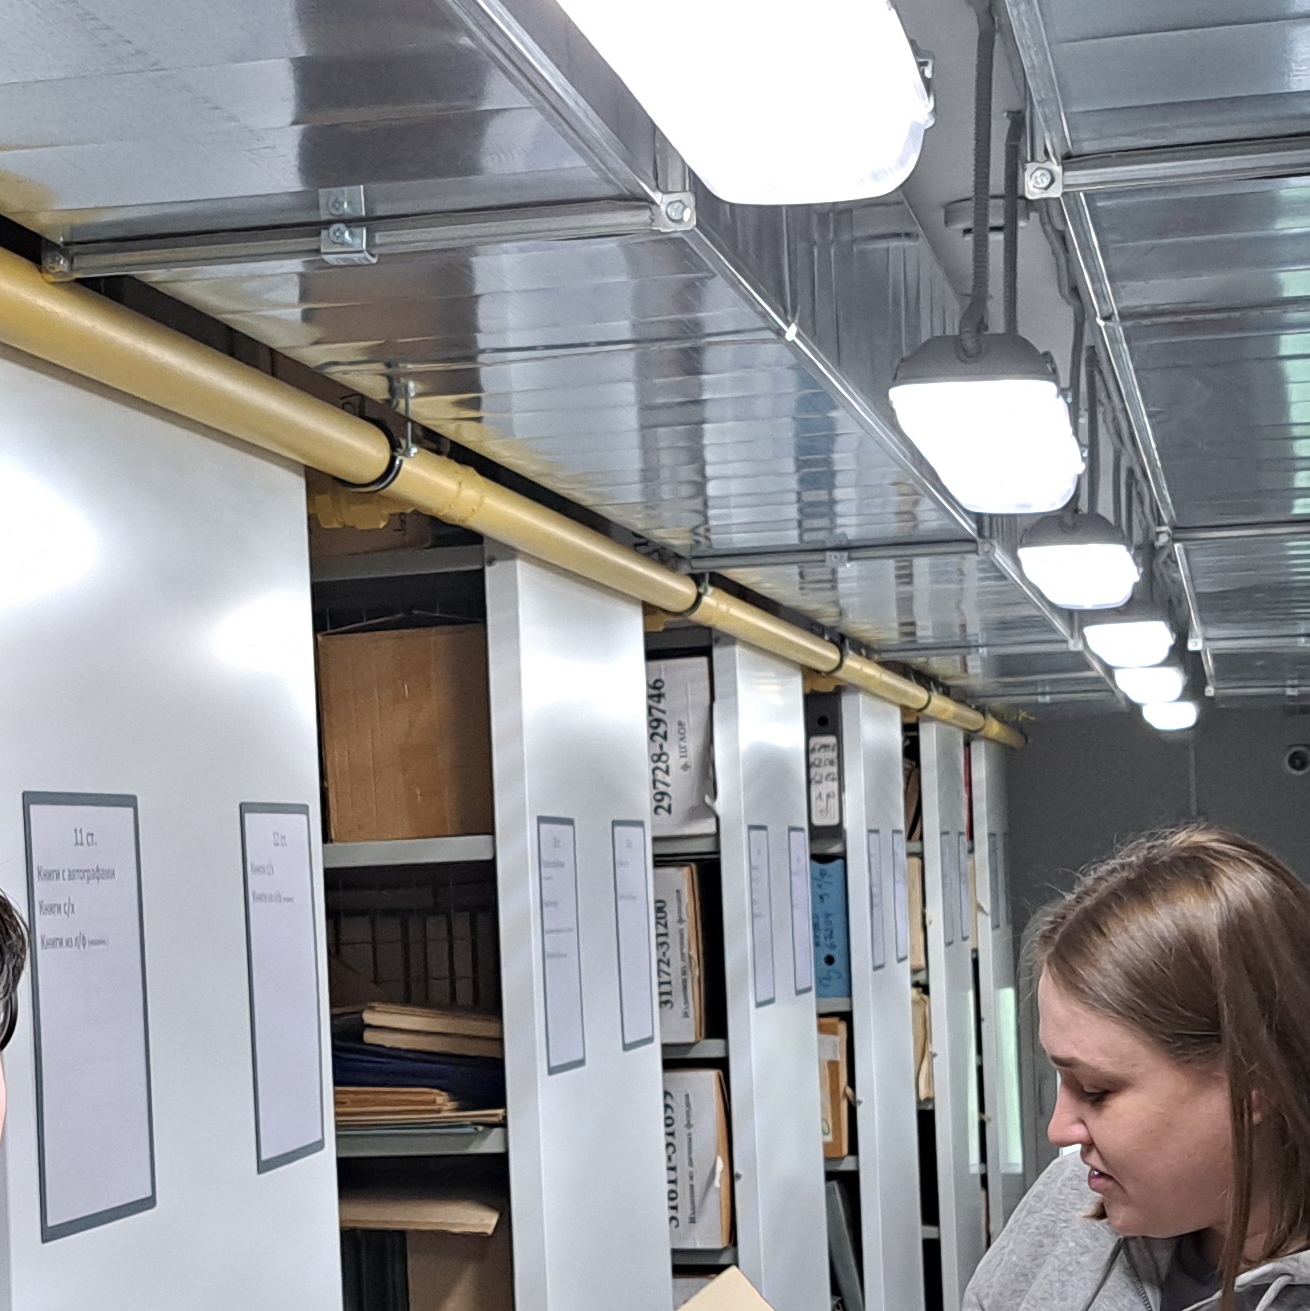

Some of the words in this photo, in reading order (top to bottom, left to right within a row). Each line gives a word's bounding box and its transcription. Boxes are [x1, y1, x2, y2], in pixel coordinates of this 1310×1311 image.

[647, 678, 672, 816] 29728-29746
[74, 827, 83, 847] 11
[37, 866, 60, 882] Книги
[67, 865, 116, 884] автографами
[39, 900, 62, 916] Книги
[655, 899, 673, 1009] 31172-31200
